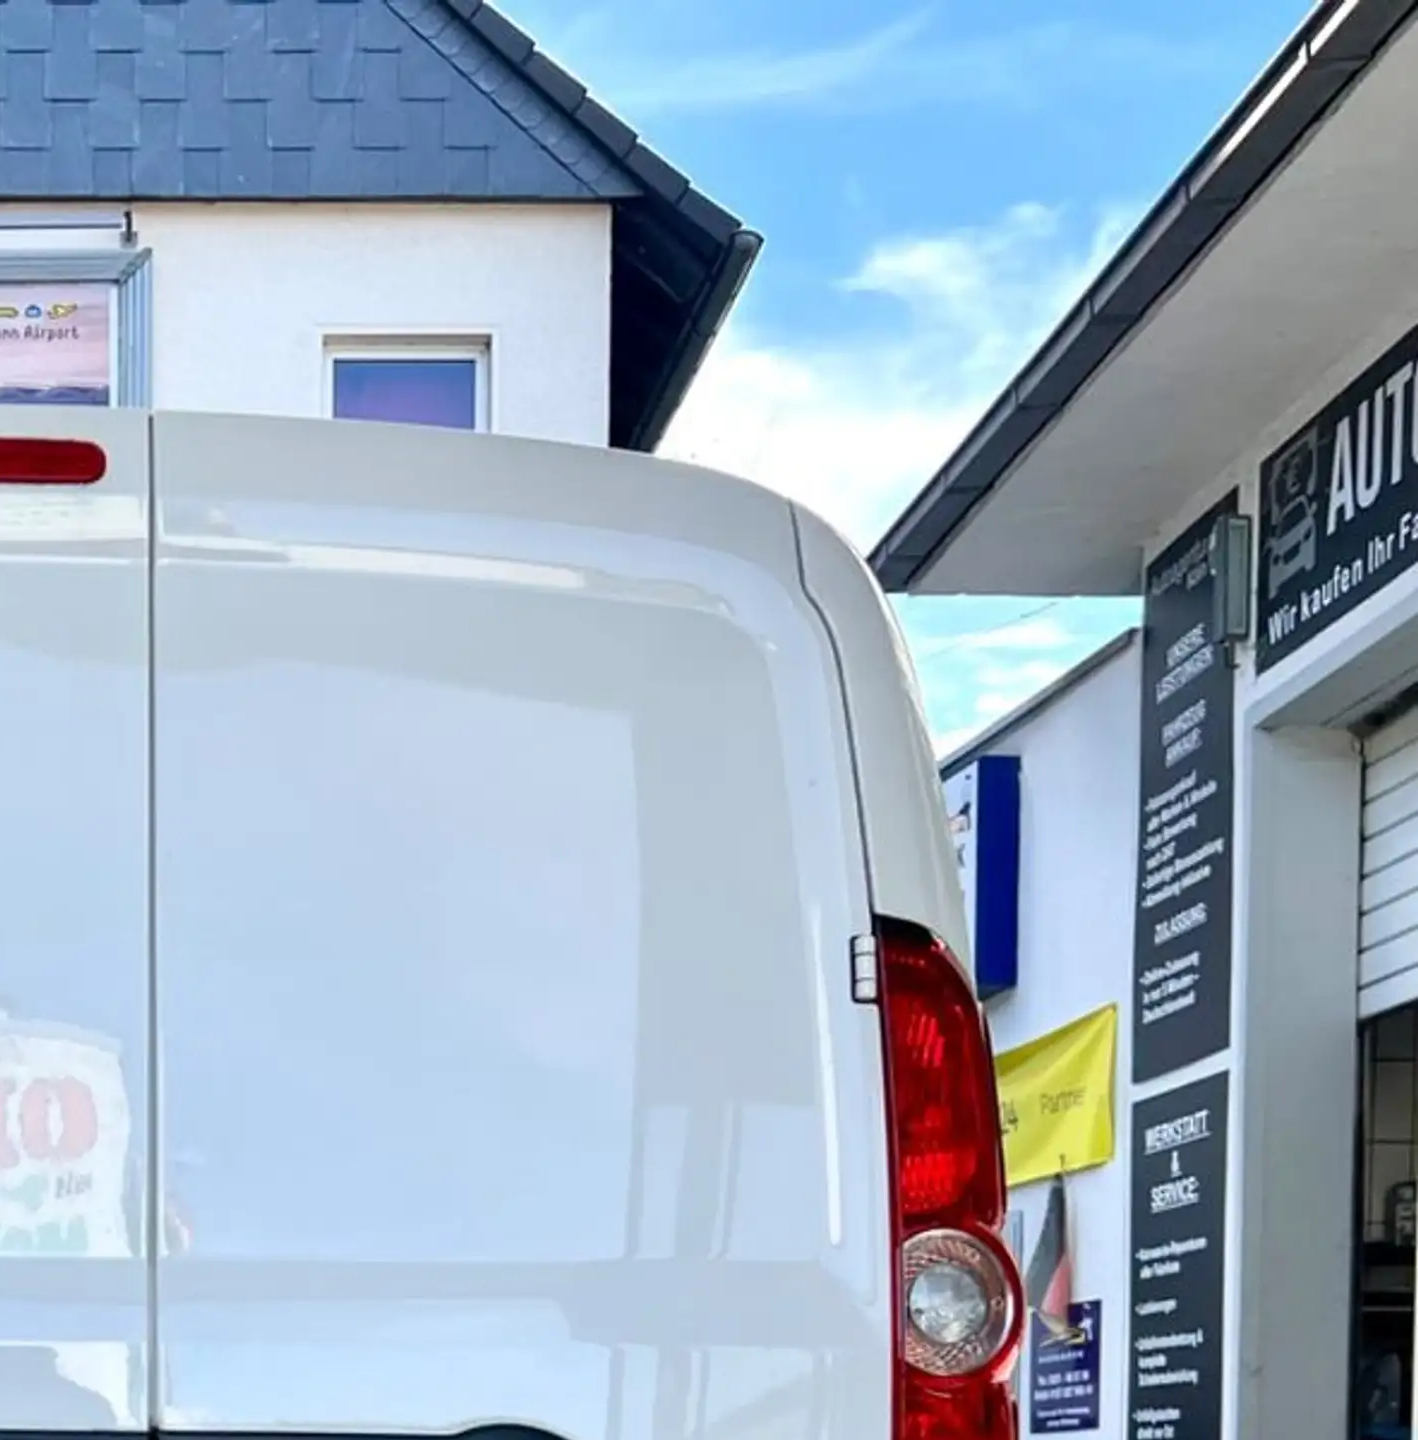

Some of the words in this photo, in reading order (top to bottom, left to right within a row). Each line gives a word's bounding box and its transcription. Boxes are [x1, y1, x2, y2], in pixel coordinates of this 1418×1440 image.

[24, 326, 79, 342] Airport
[1326, 360, 1418, 536] AUT
[1268, 604, 1297, 644] Wir
[1301, 559, 1363, 621] kaufen
[1367, 533, 1395, 575] Ihr
[1145, 1109, 1211, 1153] WERKSTATT
